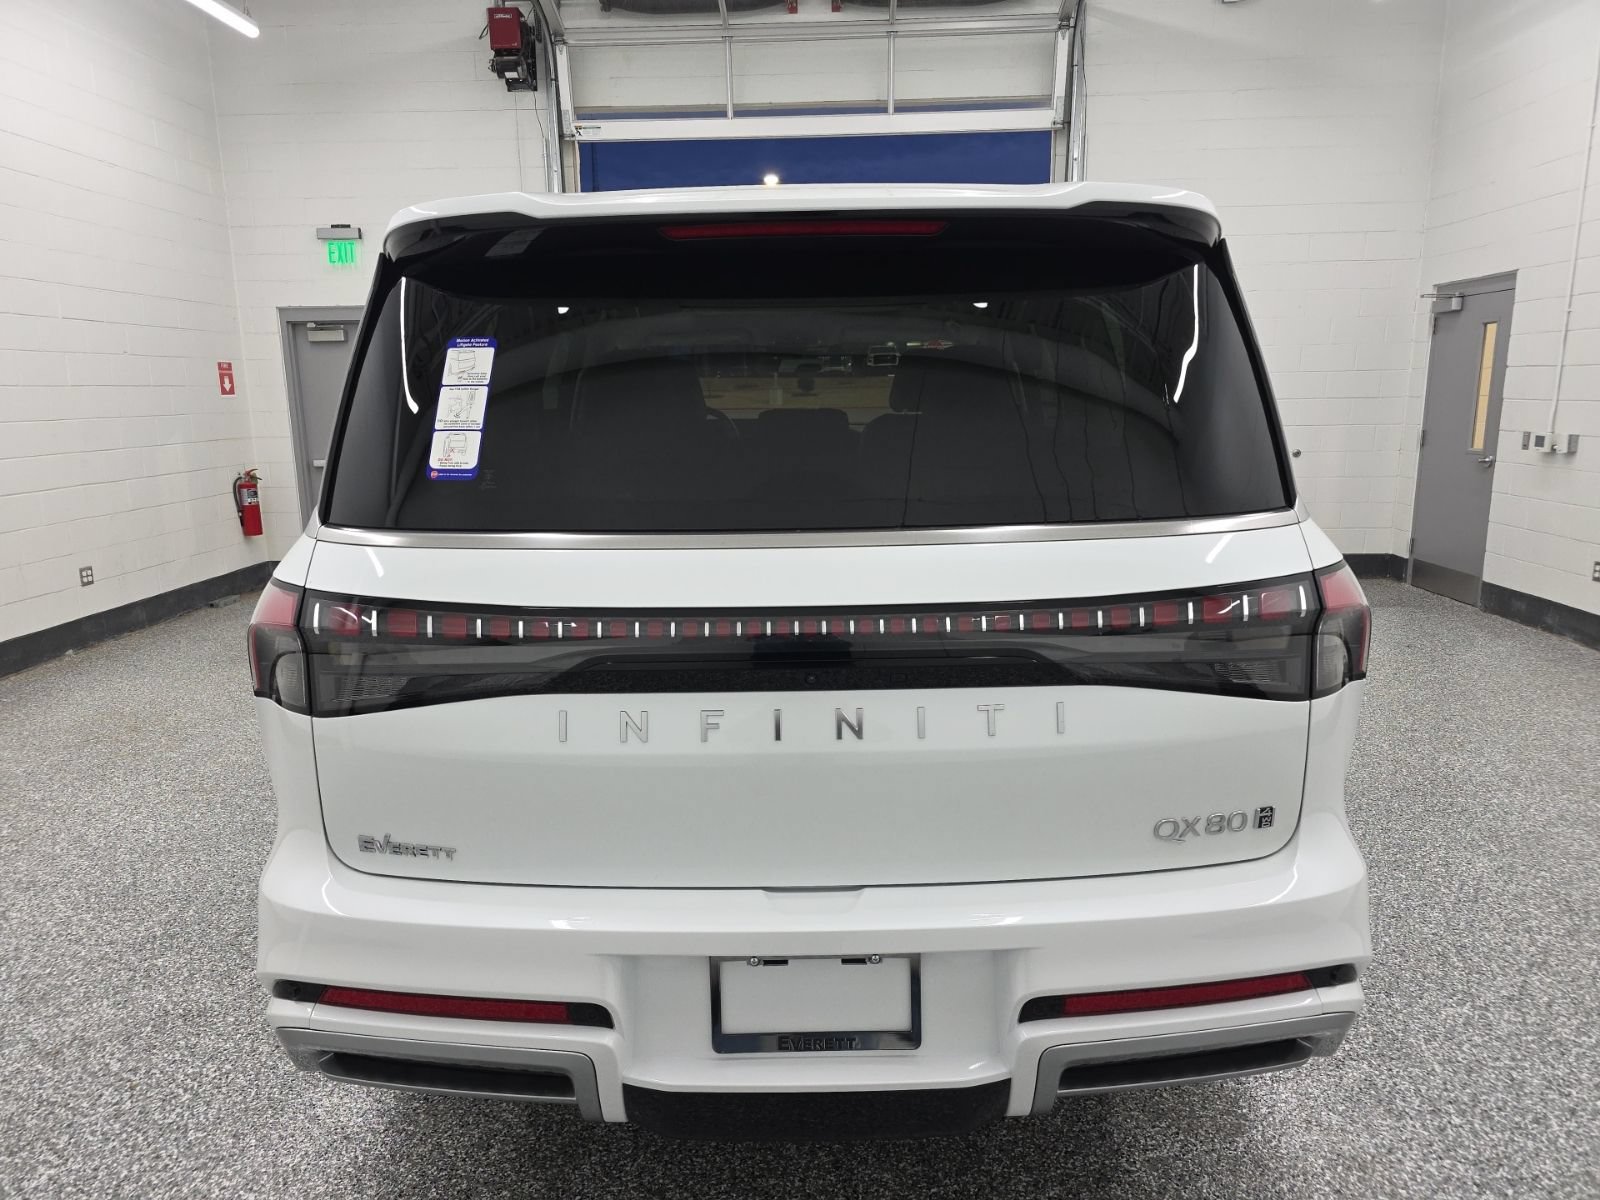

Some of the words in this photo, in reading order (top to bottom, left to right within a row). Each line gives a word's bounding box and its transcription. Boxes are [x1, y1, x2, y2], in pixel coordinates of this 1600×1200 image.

[327, 241, 355, 264] EXIT
[558, 701, 1065, 743] INFINITI
[1153, 809, 1248, 843] QX80
[357, 832, 457, 861] EVERETT
